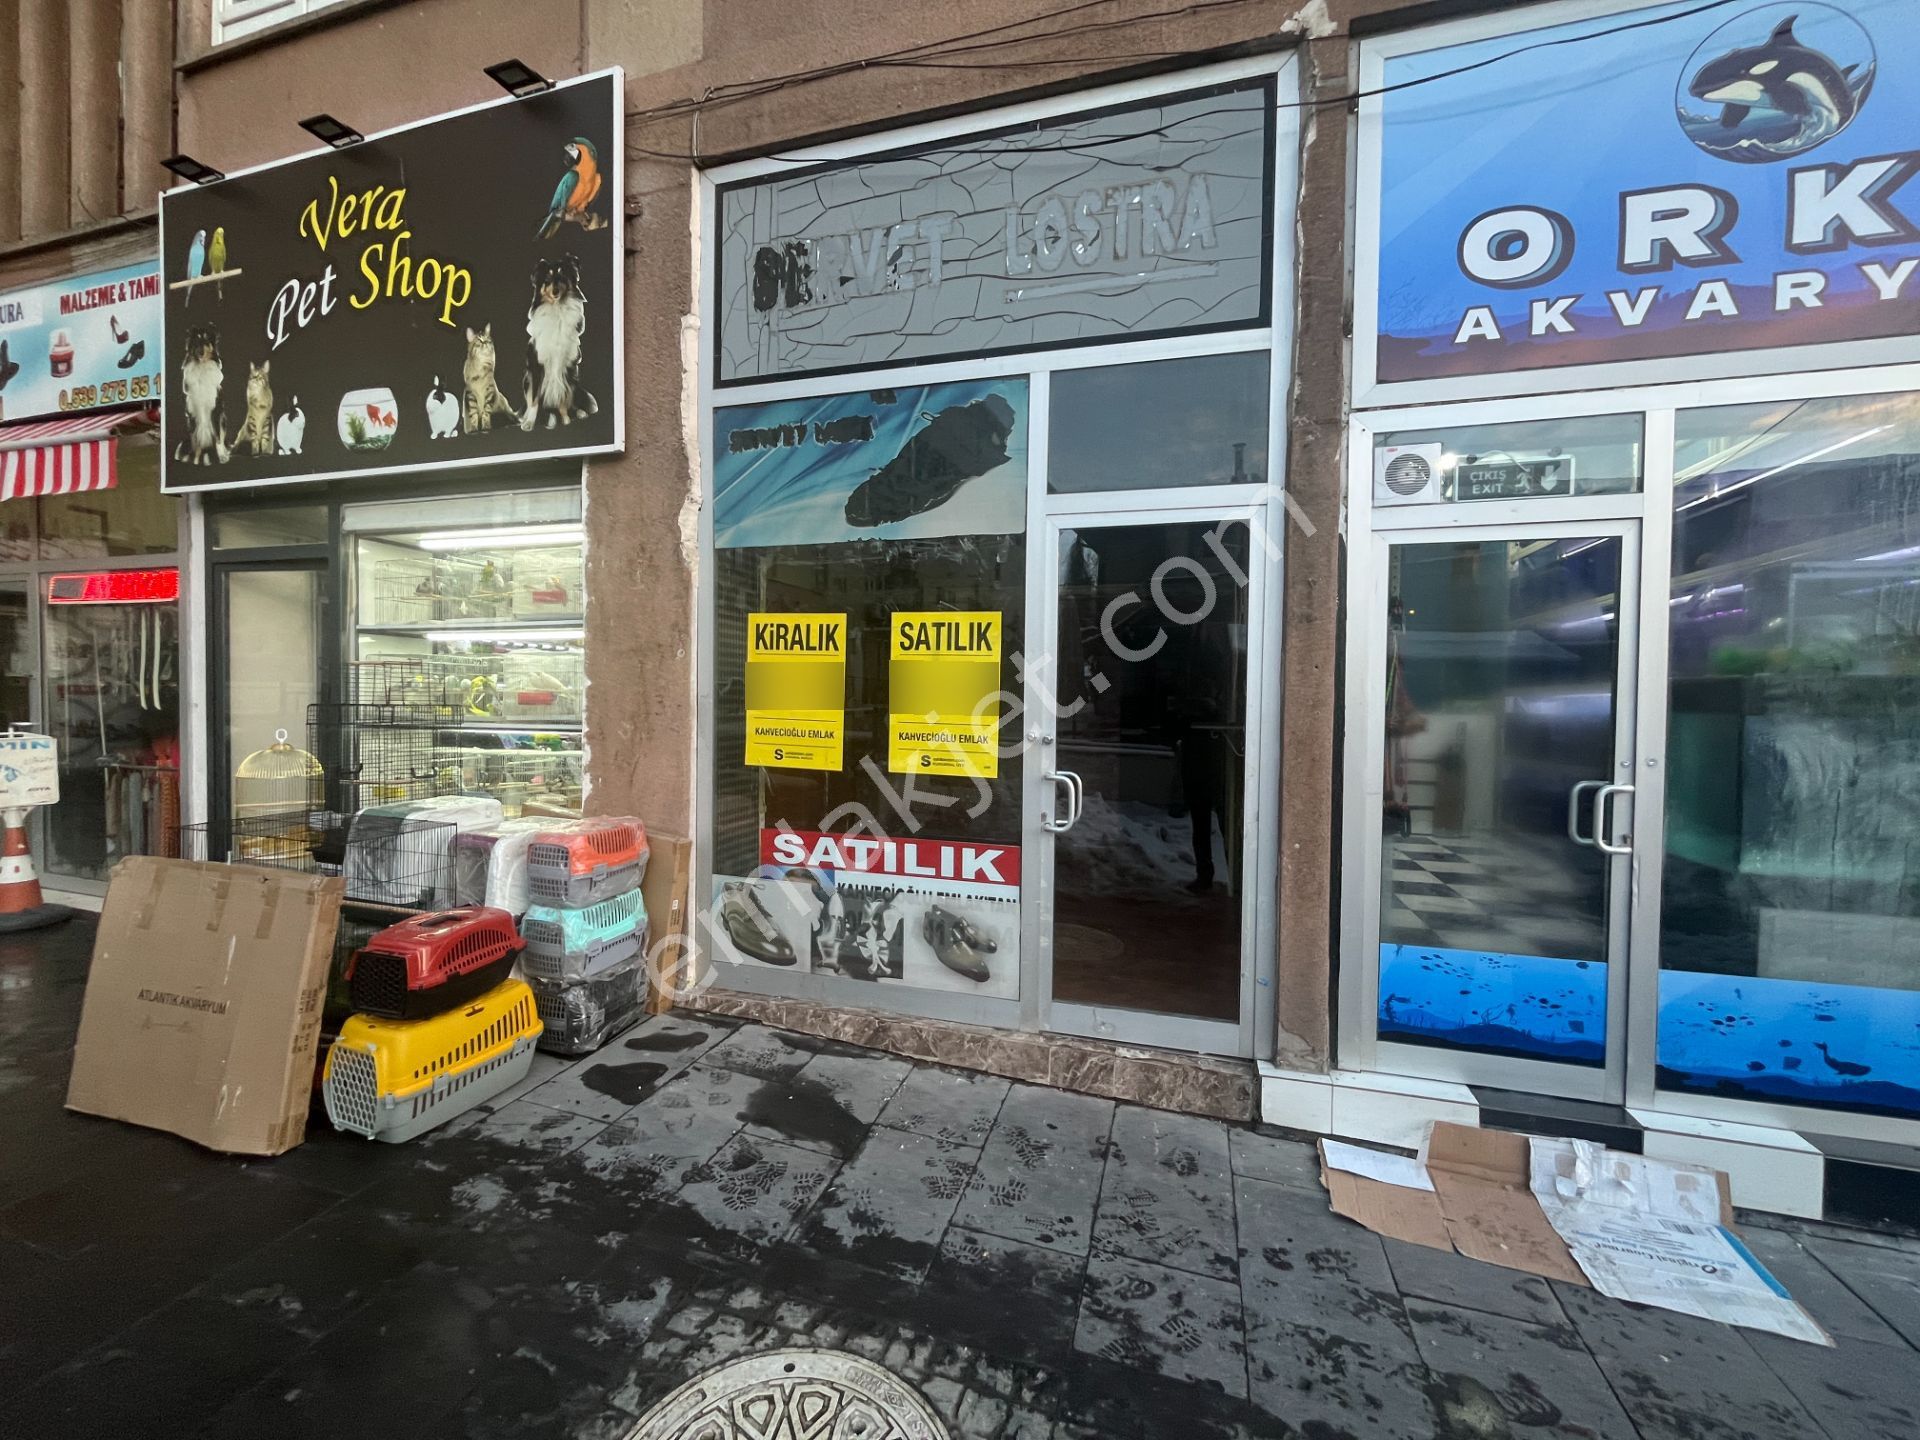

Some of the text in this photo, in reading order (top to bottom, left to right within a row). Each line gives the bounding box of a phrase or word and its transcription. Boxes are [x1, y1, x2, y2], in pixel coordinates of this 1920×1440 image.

[300, 176, 407, 252] Vera
[60, 284, 116, 315] MALZEME
[118, 282, 126, 302] &
[267, 231, 472, 351] Pet Shop
[1455, 258, 1920, 344] AKVARY
[101, 379, 127, 404] 275
[131, 375, 149, 398] 55
[1472, 484, 1504, 494] EXIT
[900, 621, 993, 651] SATILIK
[808, 730, 835, 740] EMLAK
[959, 734, 989, 745] EMLAK
[772, 833, 1006, 882] SATILIK
[180, 997, 227, 1015] AKVARYUM
